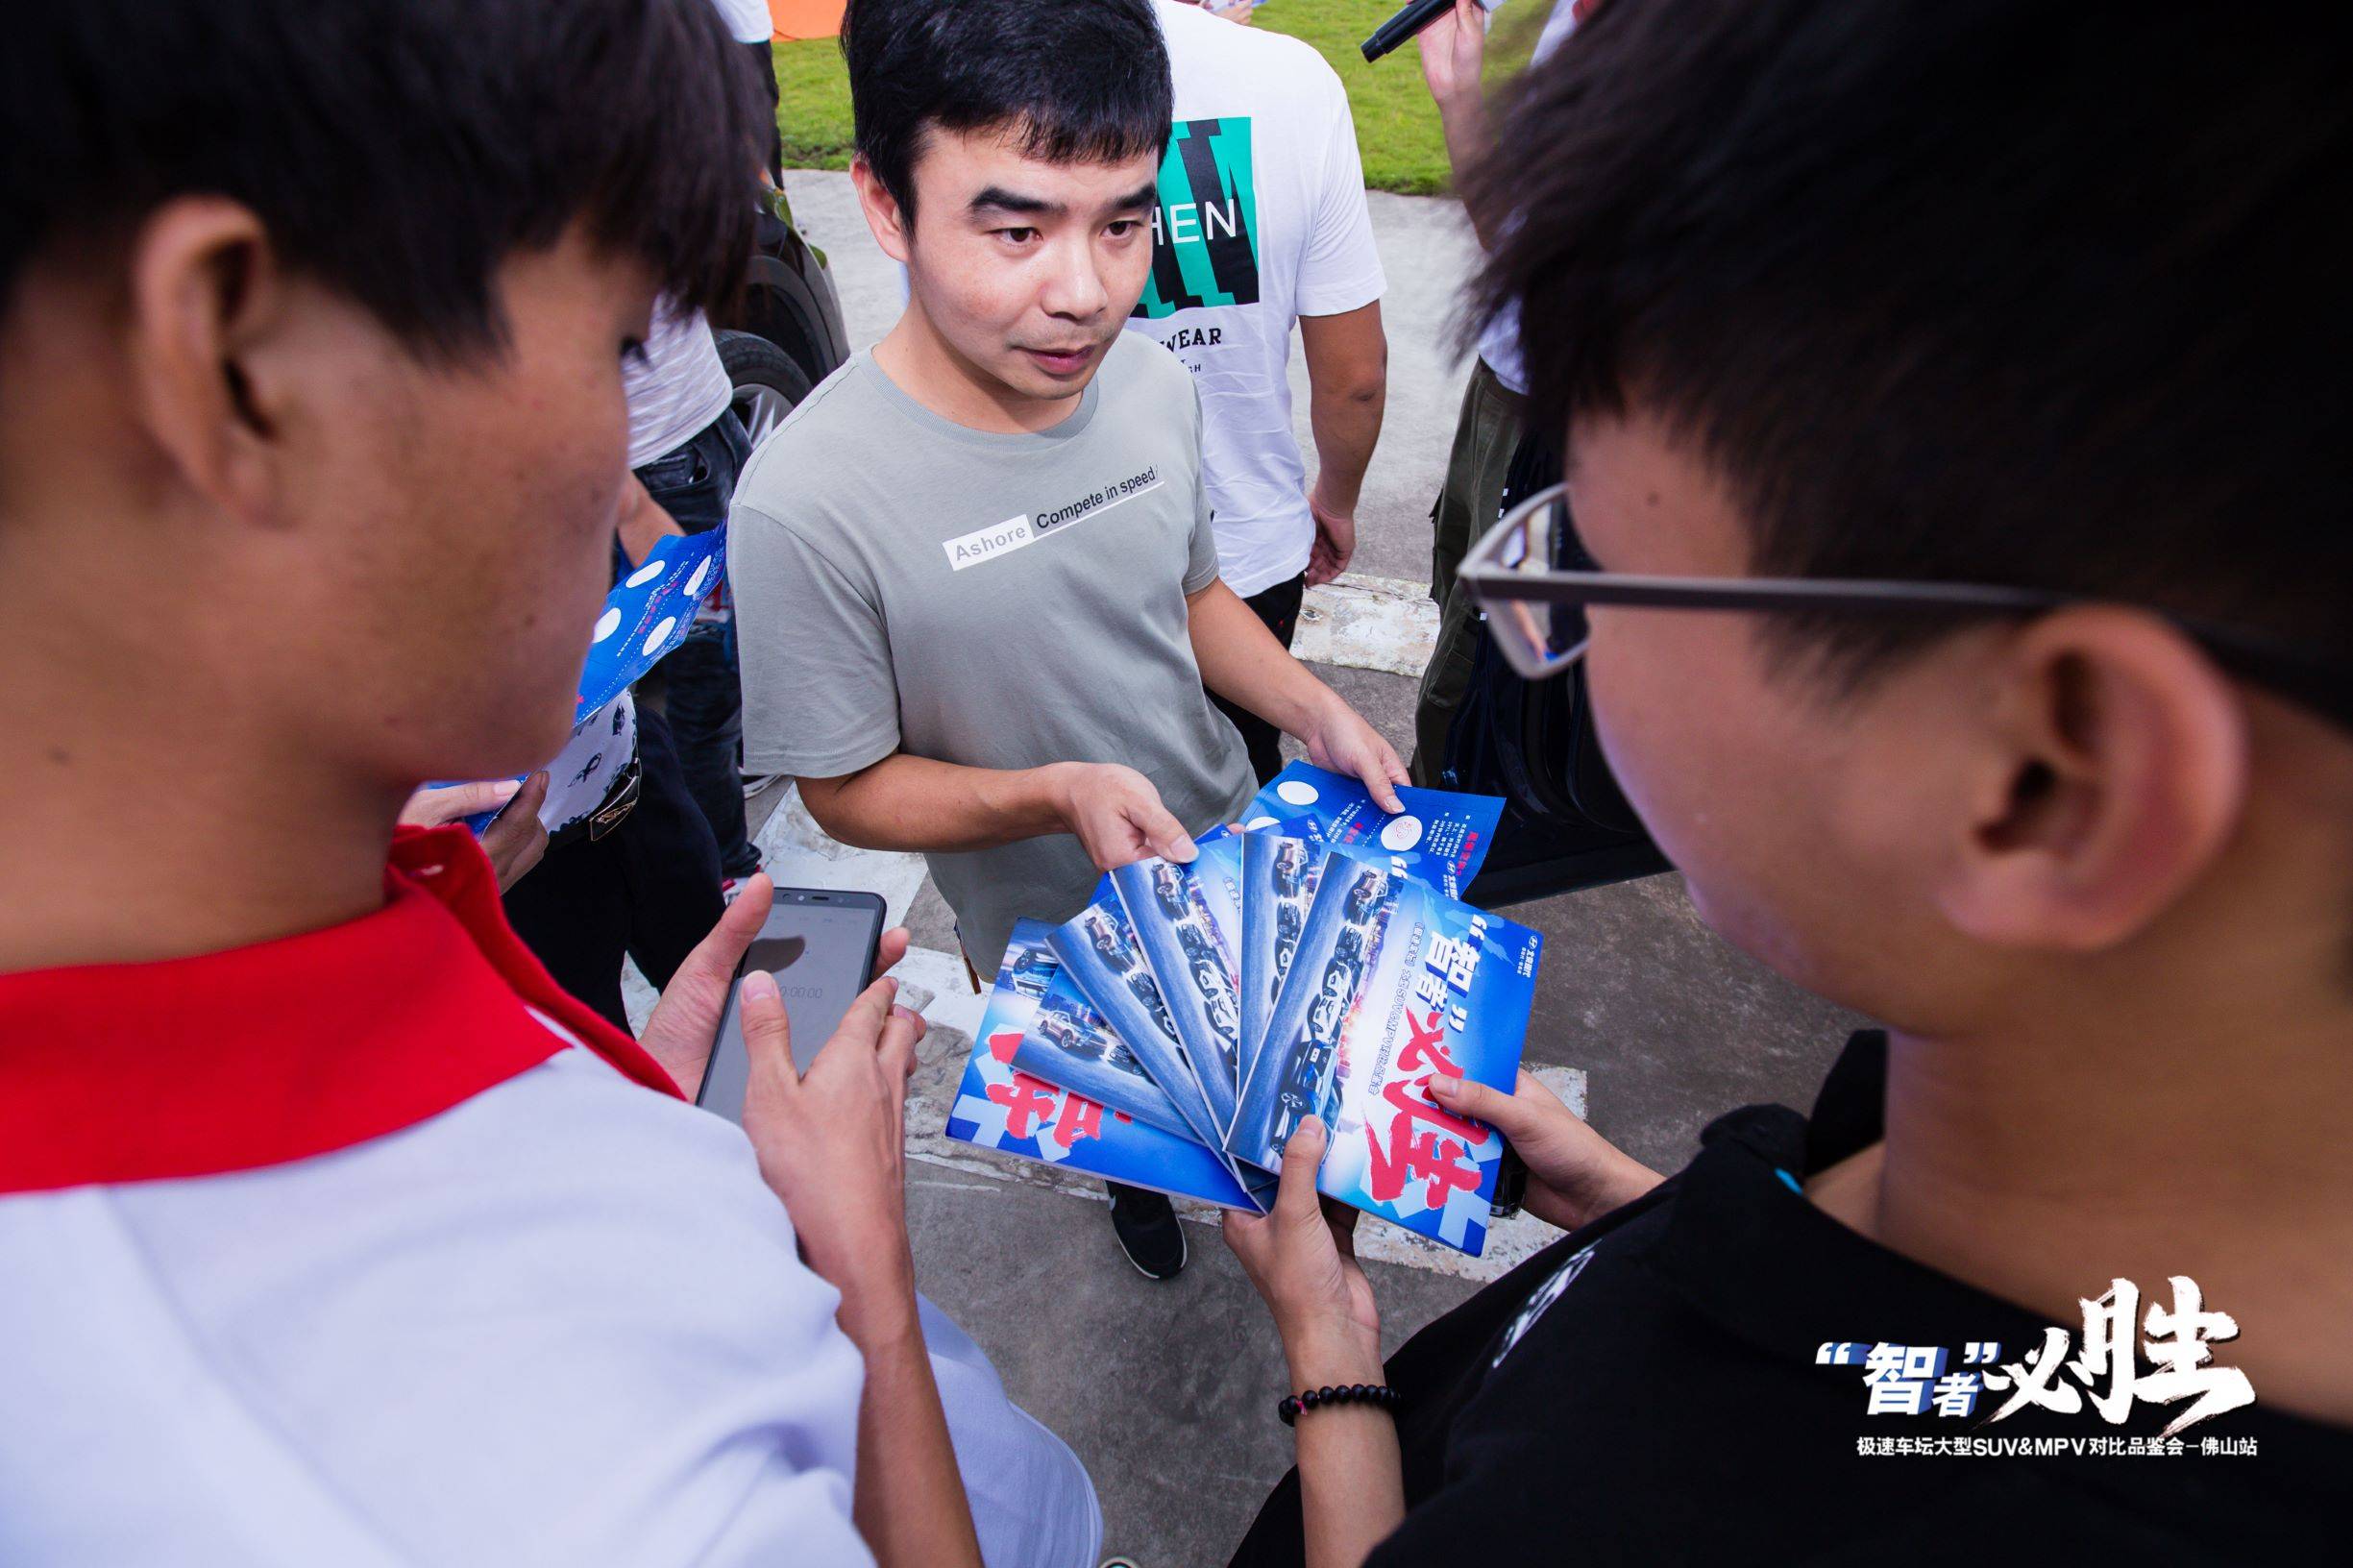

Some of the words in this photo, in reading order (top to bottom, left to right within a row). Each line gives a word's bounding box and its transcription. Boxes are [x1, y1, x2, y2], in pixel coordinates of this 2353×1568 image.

[1036, 491, 1104, 529] Compete
[1105, 485, 1118, 501] in
[955, 526, 1027, 562] Ashore
